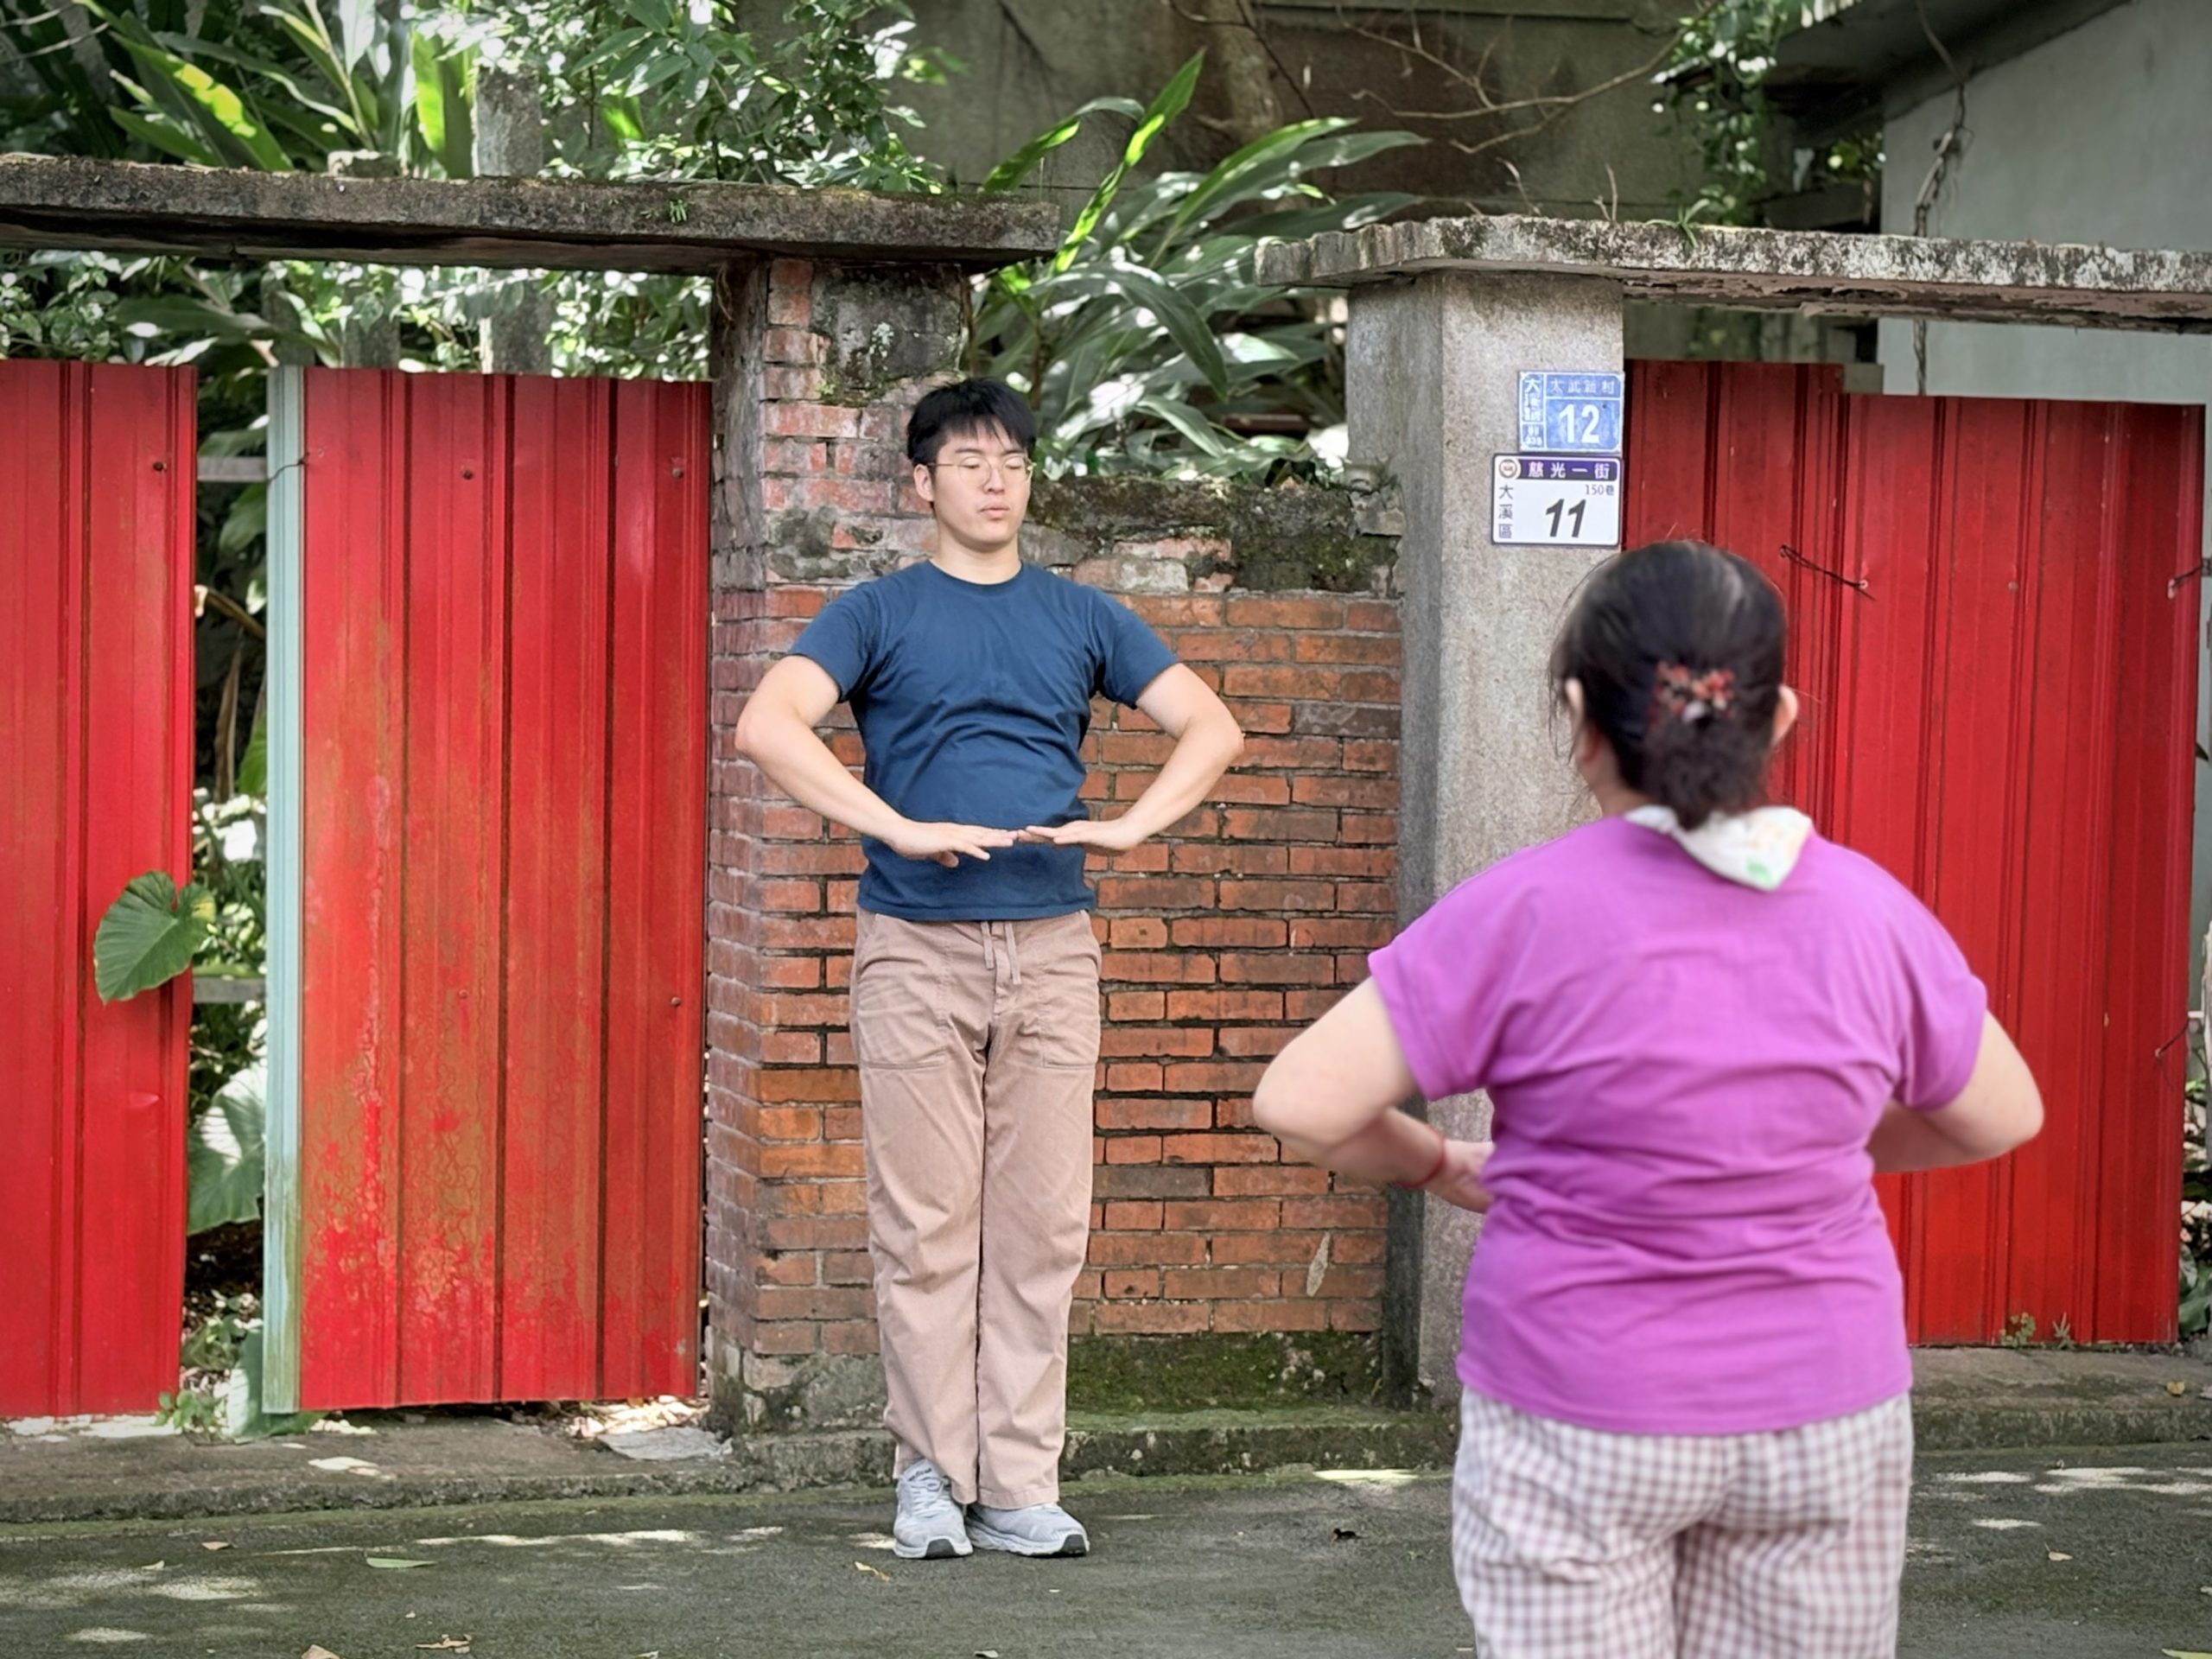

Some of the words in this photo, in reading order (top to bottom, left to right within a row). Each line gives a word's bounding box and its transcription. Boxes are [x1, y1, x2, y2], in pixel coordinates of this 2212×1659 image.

[1559, 404, 1600, 443] 12
[1529, 461, 1610, 480] 慈光一街
[1498, 485, 1514, 539] 大溪區
[1545, 499, 1586, 538] 11
